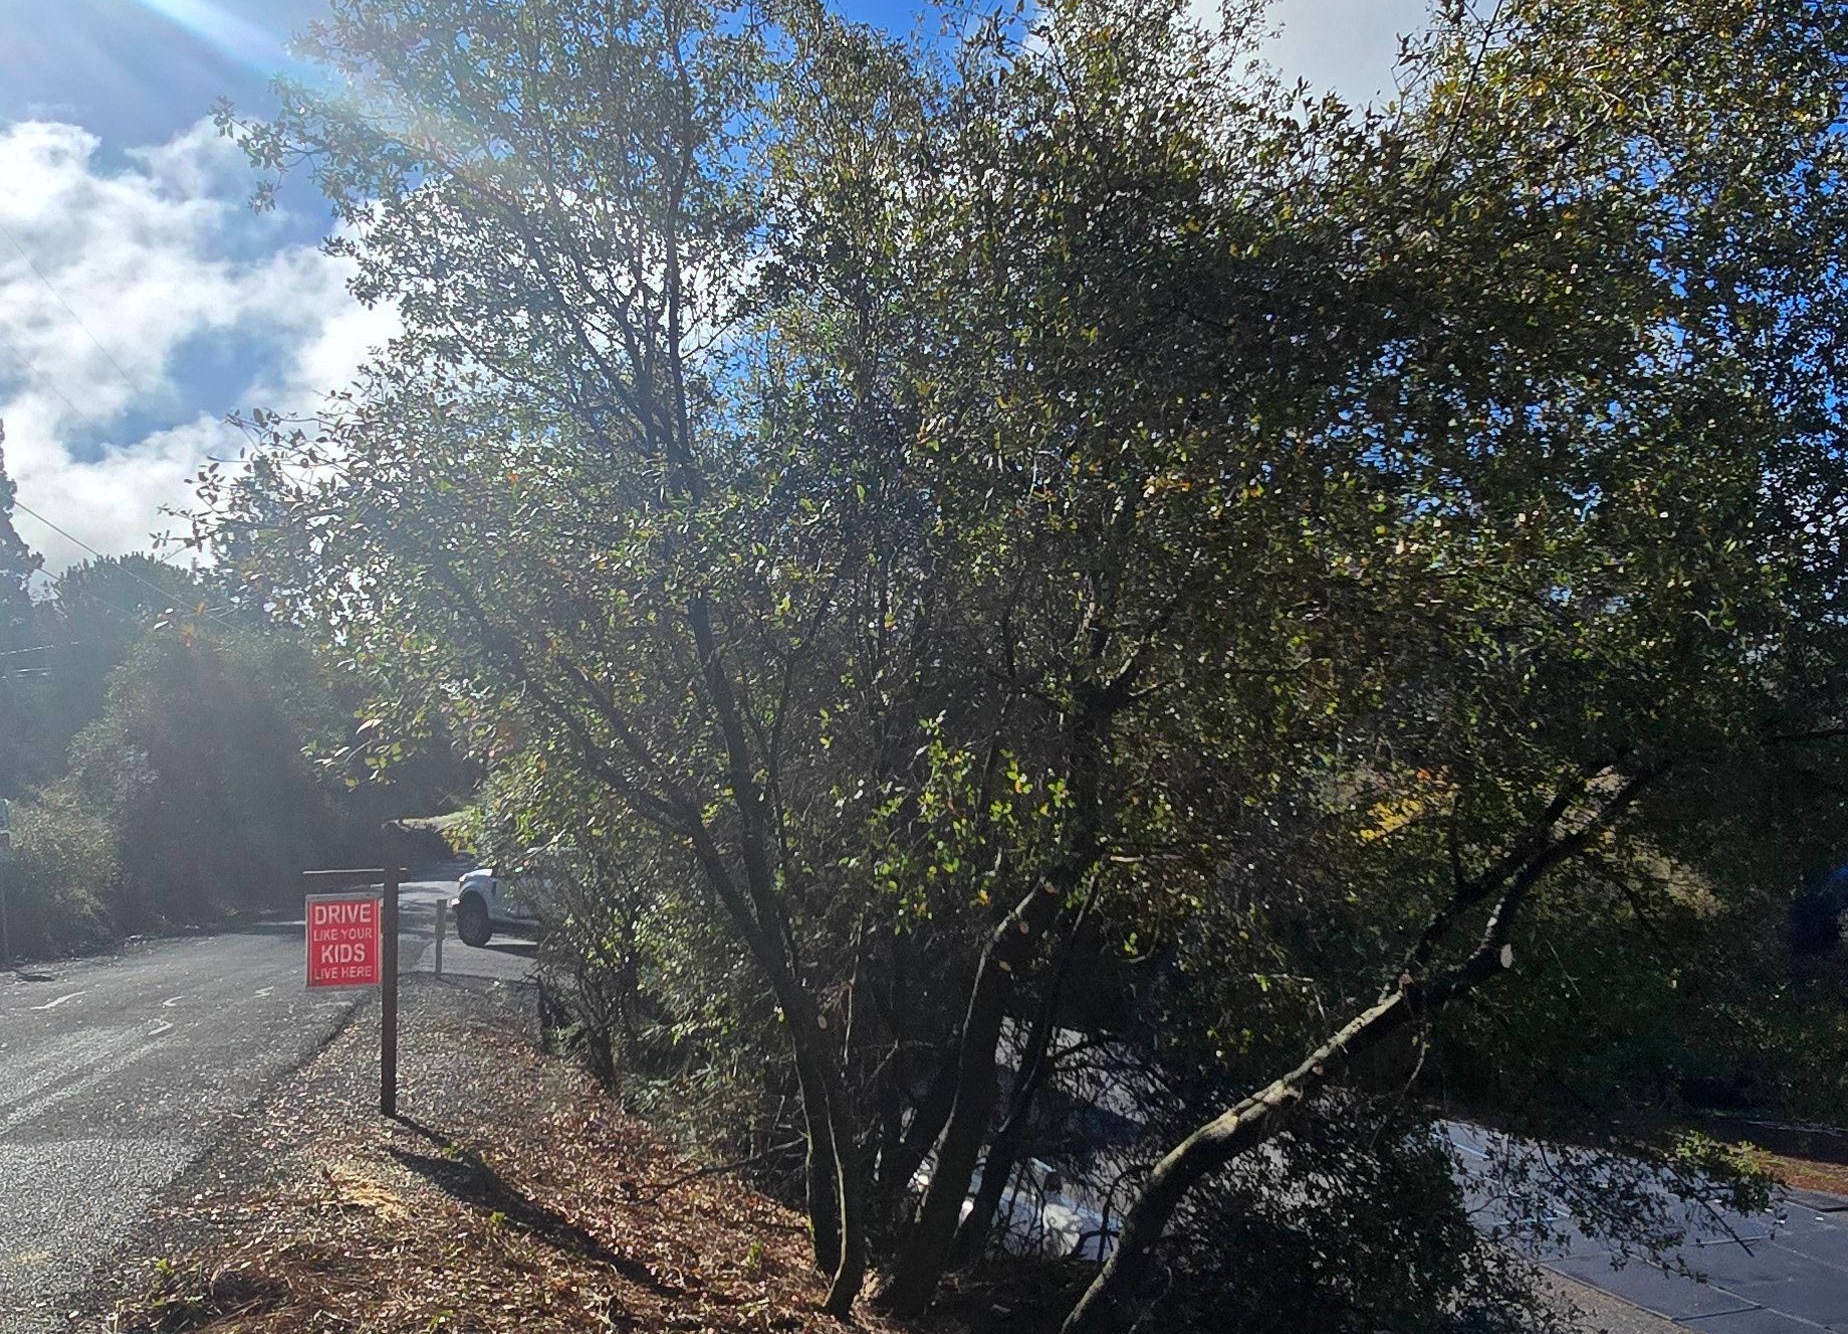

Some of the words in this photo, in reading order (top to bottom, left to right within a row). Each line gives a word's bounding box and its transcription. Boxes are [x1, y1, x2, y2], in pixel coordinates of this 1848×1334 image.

[315, 904, 371, 925] DRIVE
[313, 929, 338, 942] LIKE
[341, 928, 372, 940] YOUR
[321, 943, 365, 964] KIDS
[314, 967, 338, 980] LIVE
[341, 966, 372, 978] HERE
